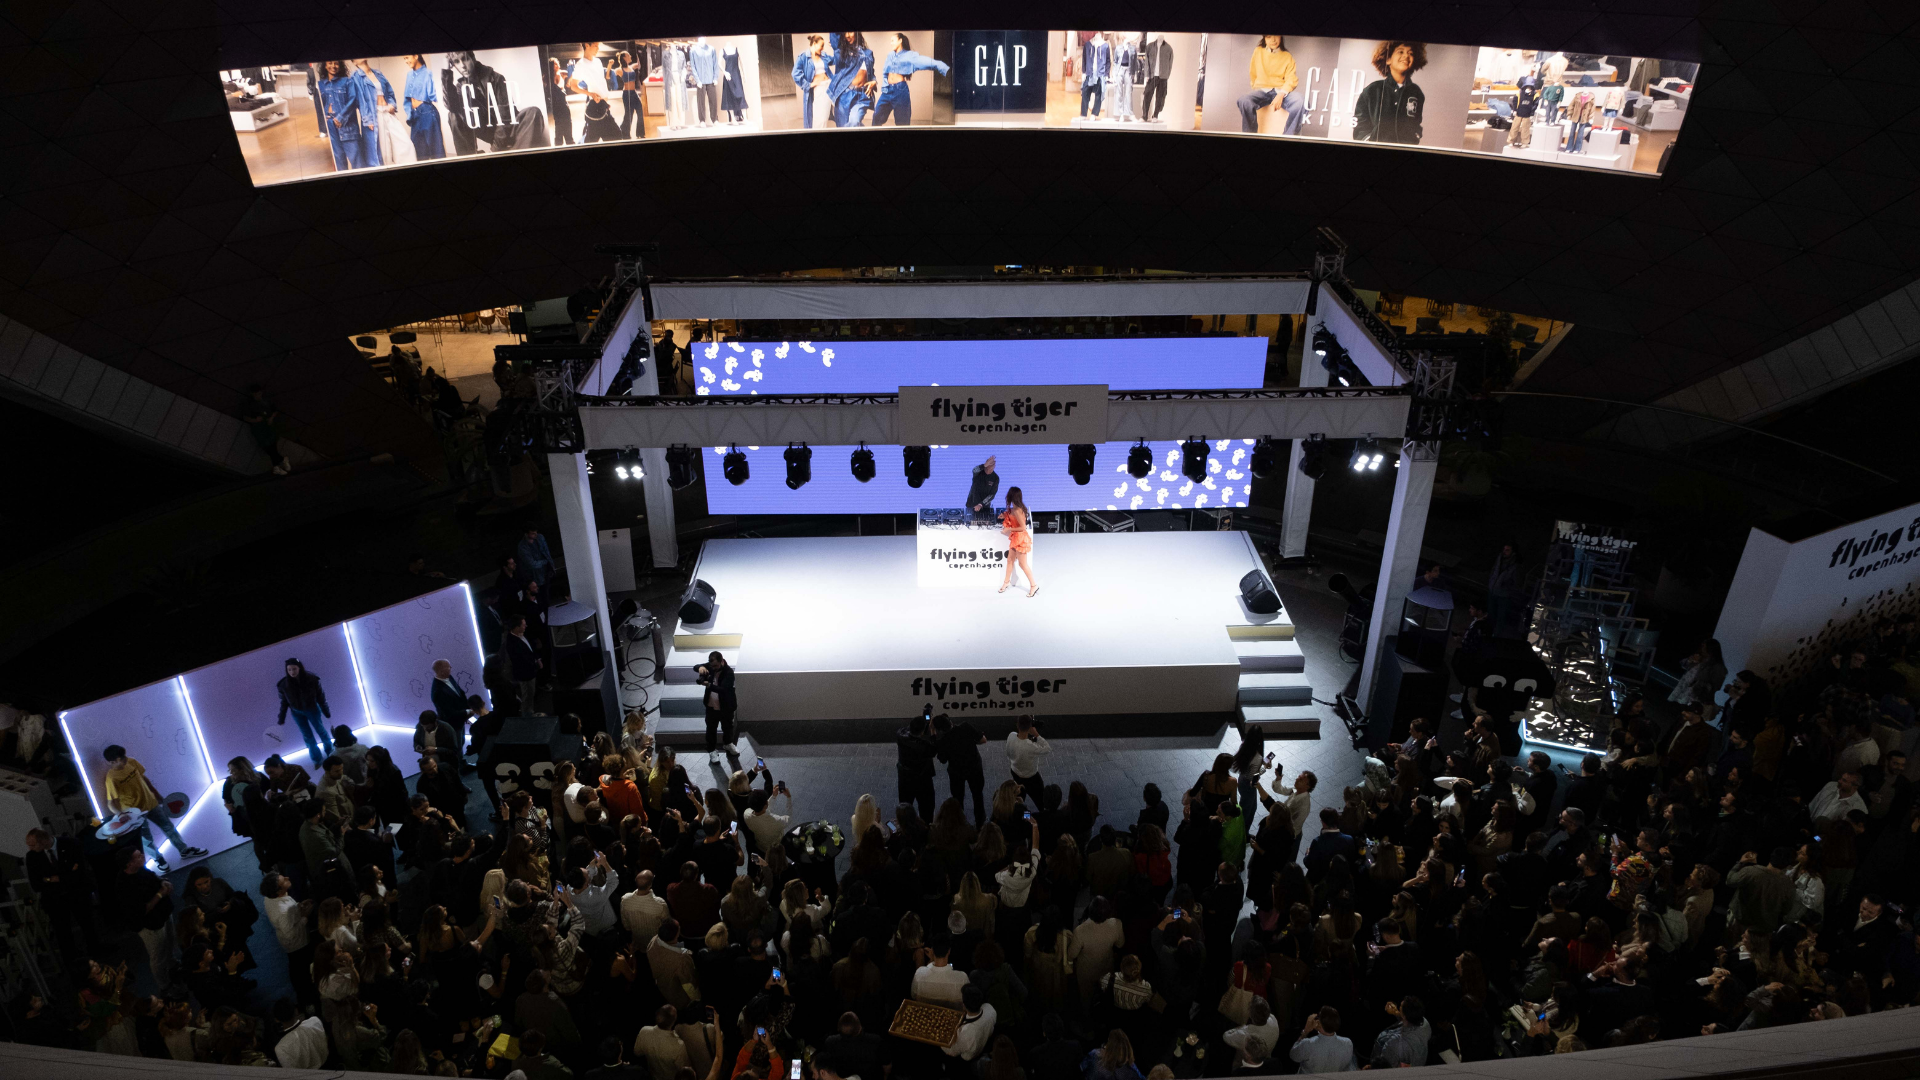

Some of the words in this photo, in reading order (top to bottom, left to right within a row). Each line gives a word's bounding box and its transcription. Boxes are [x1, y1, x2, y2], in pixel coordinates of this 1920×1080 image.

[974, 44, 1027, 87] GAP
[1303, 66, 1366, 114] GAP
[461, 81, 520, 129] GAP
[1301, 113, 1359, 128] KIDS
[930, 397, 1006, 422] flying
[1010, 396, 1078, 422] tiger
[960, 422, 1047, 434] copenhagen
[930, 548, 977, 562] flying
[979, 547, 1010, 562] tig
[1601, 535, 1638, 549] tiger
[1829, 526, 1904, 568] flying
[911, 676, 991, 700] flying
[996, 675, 1067, 698] tiger
[943, 699, 1035, 711] copenhagen
